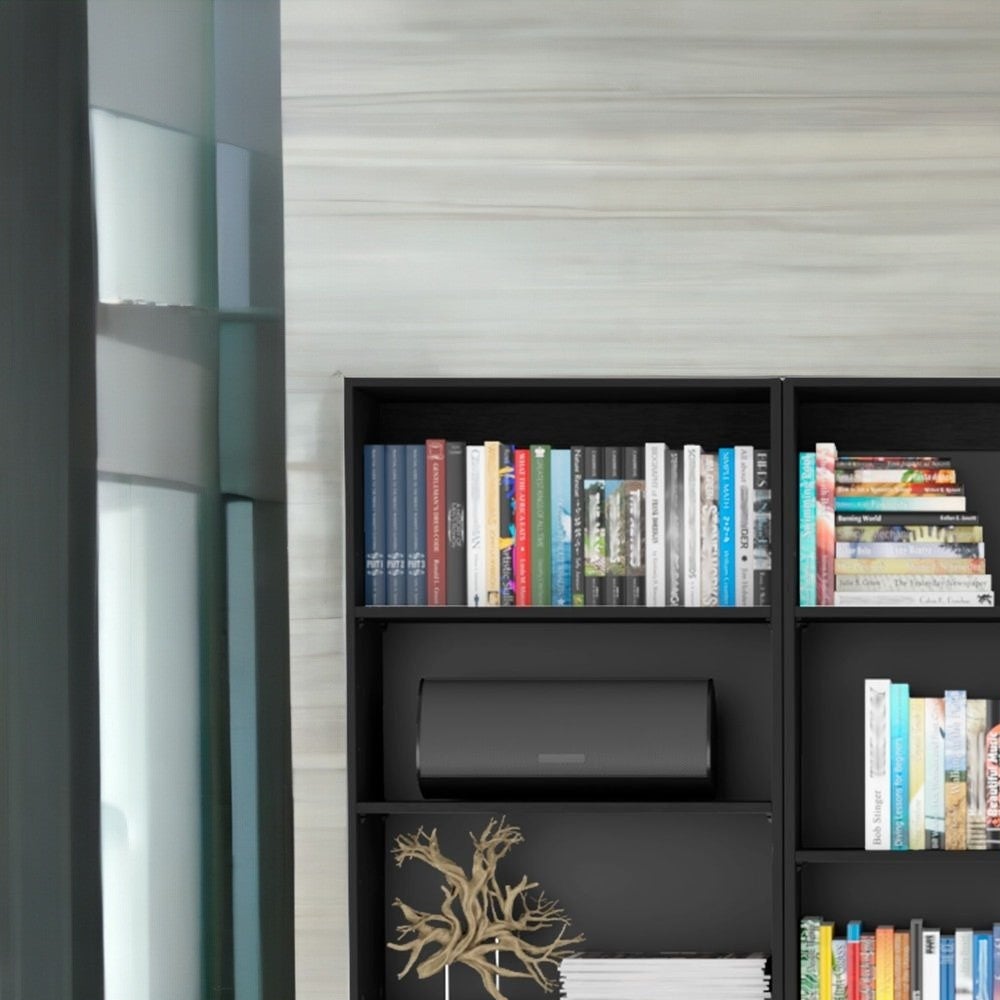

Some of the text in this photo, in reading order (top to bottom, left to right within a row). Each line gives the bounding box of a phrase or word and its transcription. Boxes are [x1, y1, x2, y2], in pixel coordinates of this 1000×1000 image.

[519, 453, 527, 476] WHAT
[519, 478, 527, 492] THE
[722, 483, 730, 509] MATH
[519, 493, 527, 520] AFRICA
[519, 521, 527, 541] EATS
[872, 790, 884, 823] Stinger
[894, 788, 905, 819] Lessons
[872, 826, 884, 845] Bob
[894, 821, 905, 847] Diving
